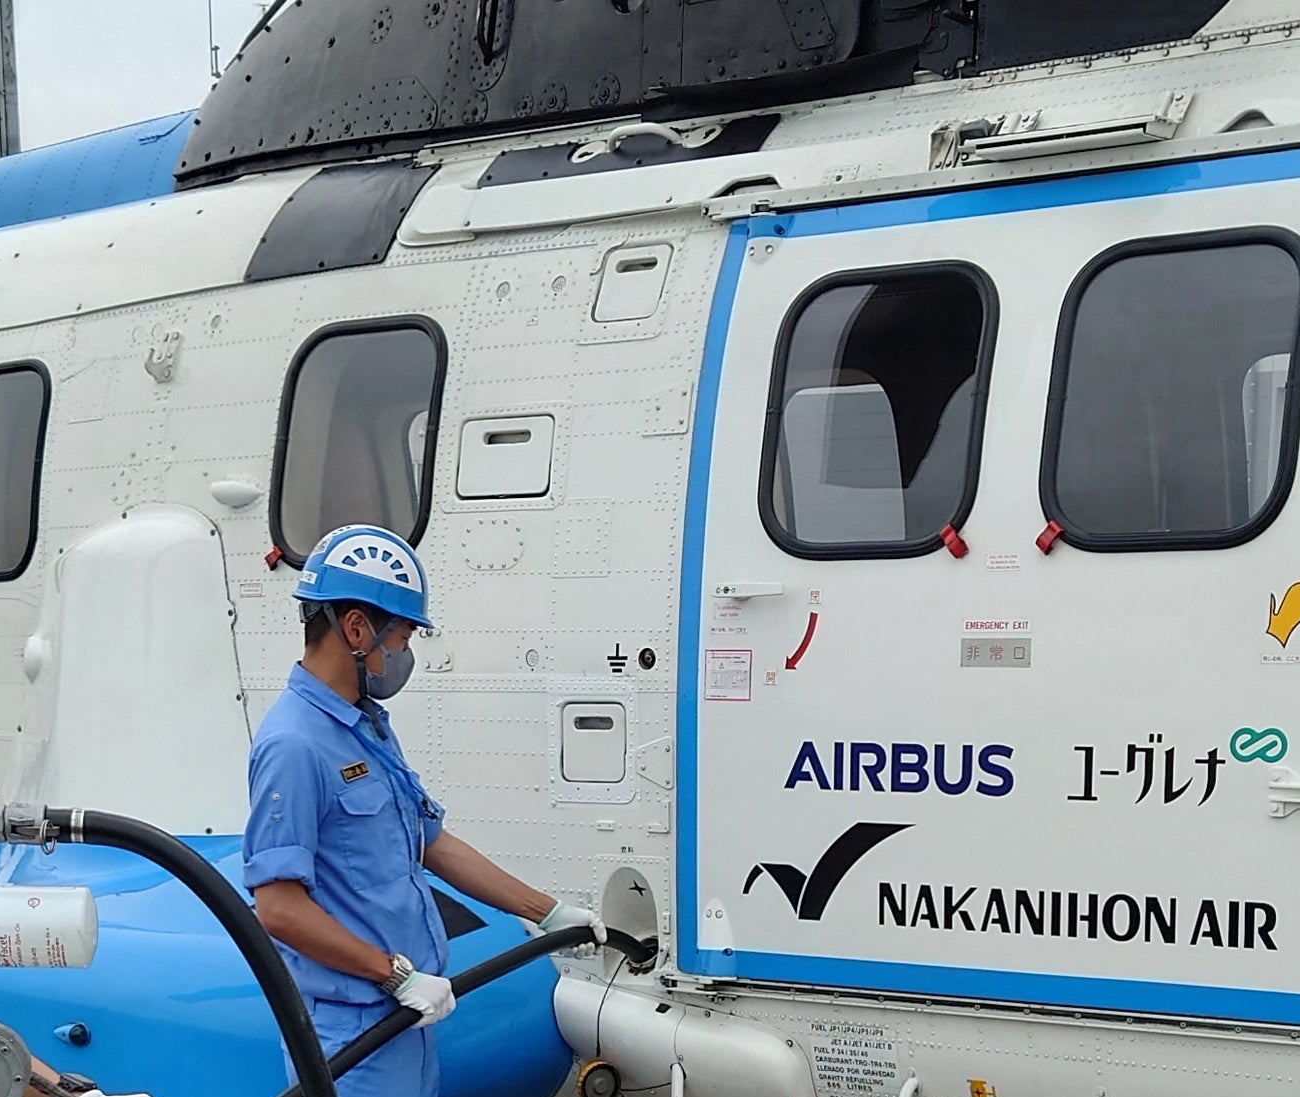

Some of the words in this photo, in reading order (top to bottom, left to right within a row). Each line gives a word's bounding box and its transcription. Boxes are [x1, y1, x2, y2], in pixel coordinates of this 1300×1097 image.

[965, 621, 1009, 630] EMERGENCY
[1012, 621, 1029, 630] EXIT
[966, 645, 1026, 661] 非常口
[784, 740, 1015, 797] AIRBUS
[1066, 733, 1227, 807] ユーグレナ
[878, 882, 1177, 945] NAKANIHON
[1190, 899, 1278, 951] AIR
[811, 1023, 827, 1032] FUEL
[814, 1046, 829, 1054] FUEL
[816, 1065, 844, 1074] LLENADO
[847, 1067, 860, 1075] POR
[862, 1069, 895, 1079] GRAVEDAD
[818, 1073, 844, 1082] GRAVITY
[847, 1084, 873, 1092] LITRES
